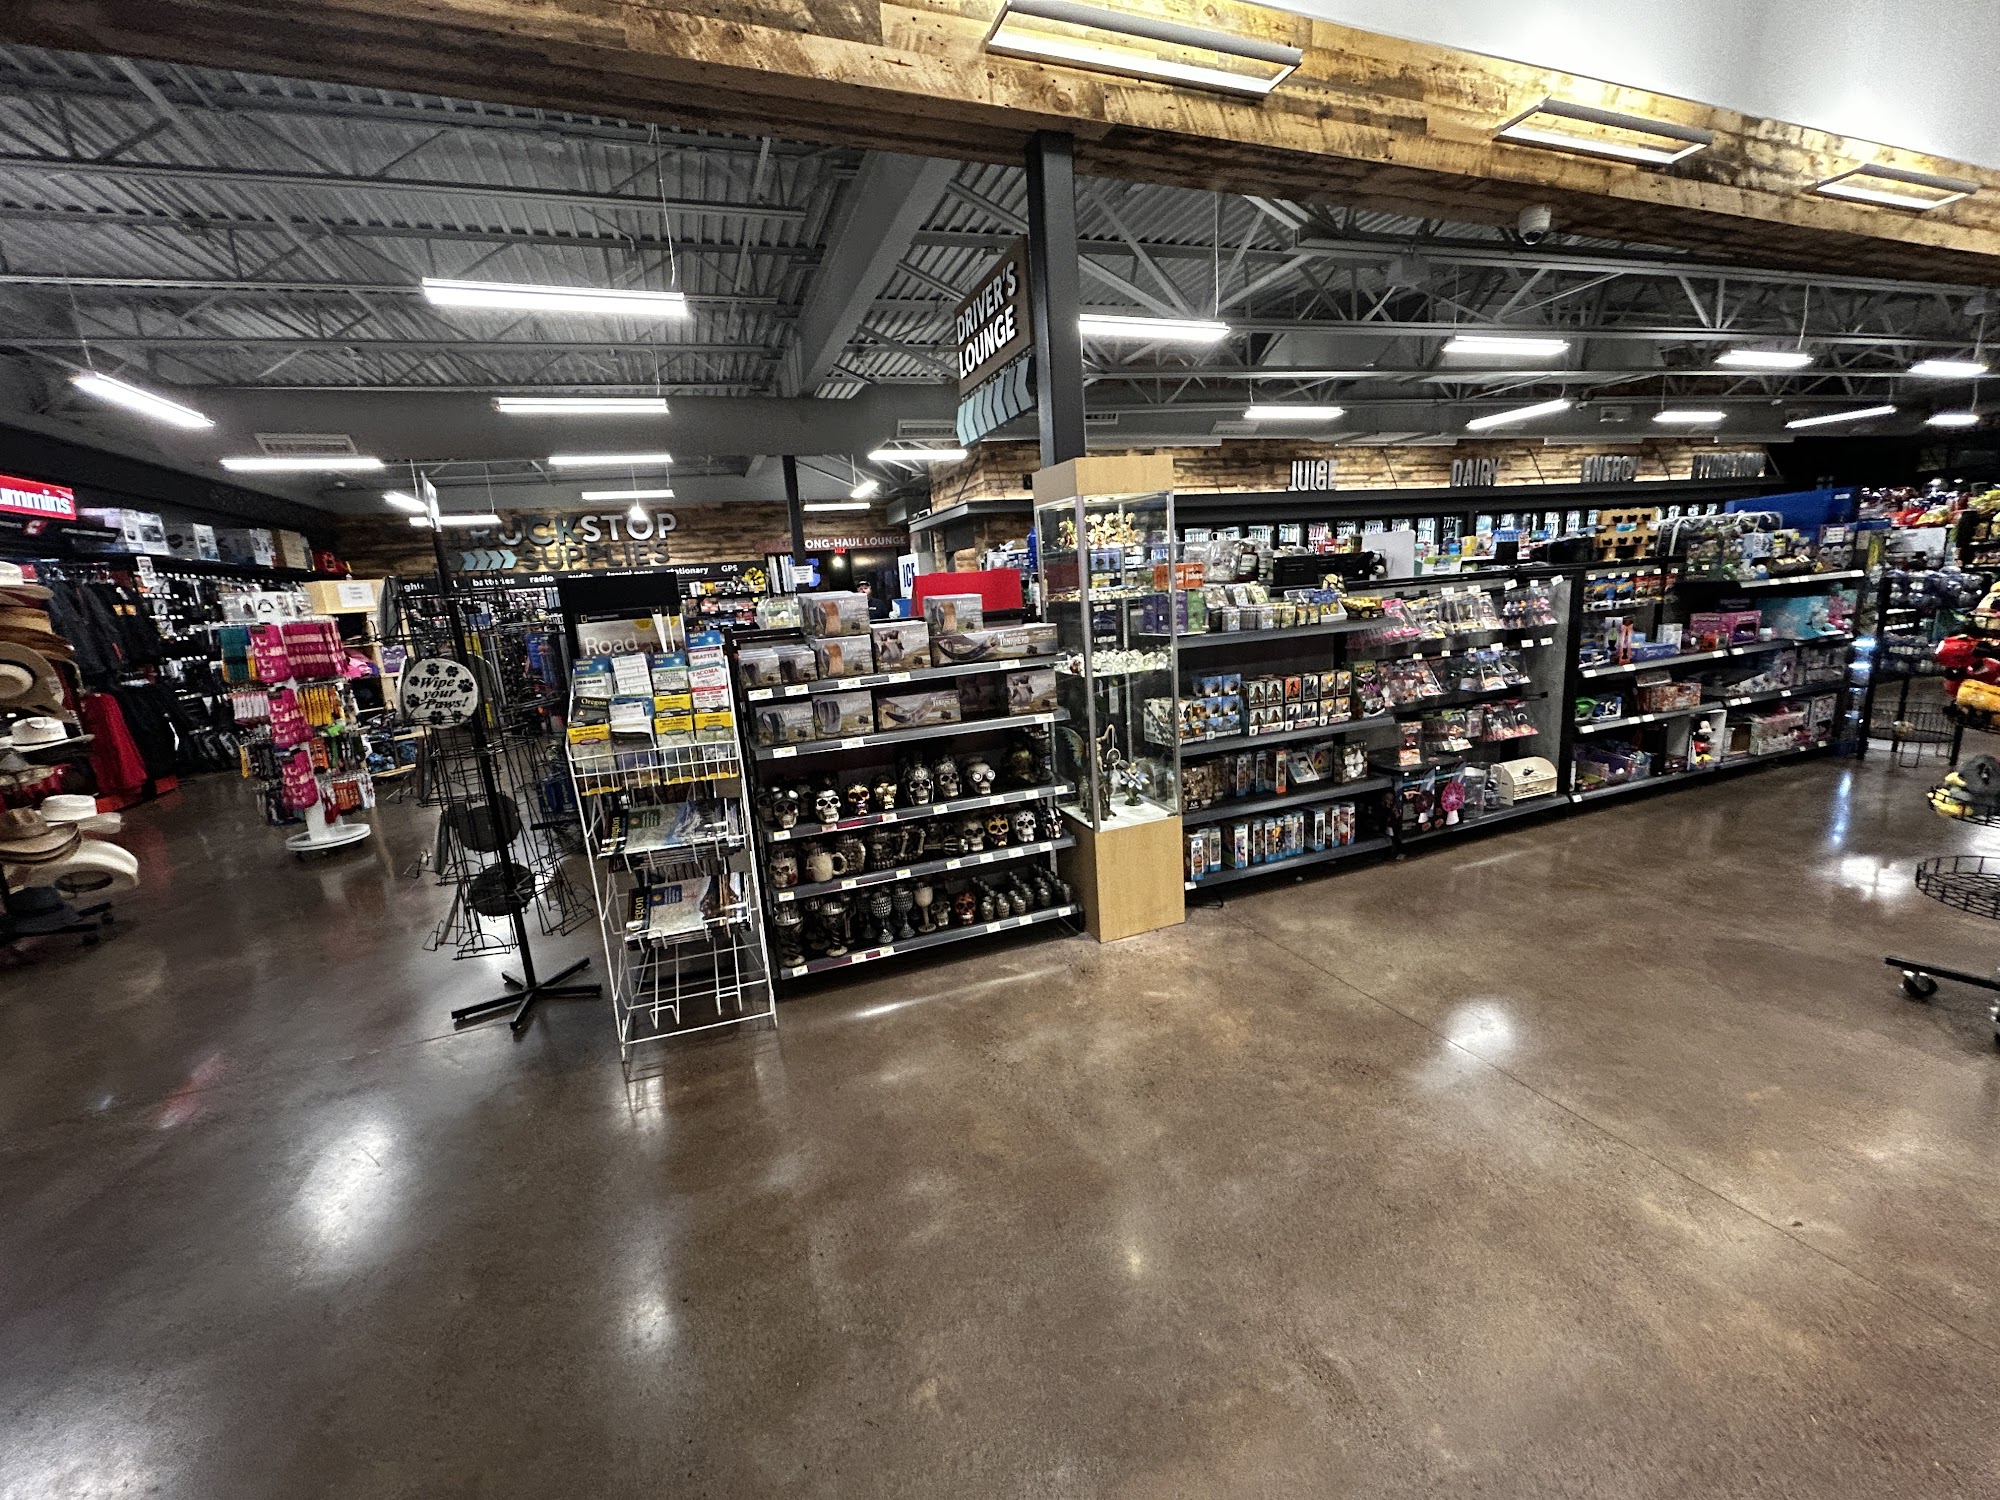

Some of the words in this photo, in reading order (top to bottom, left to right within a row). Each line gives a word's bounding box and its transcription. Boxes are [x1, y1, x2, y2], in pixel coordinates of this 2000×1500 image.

[956, 261, 1017, 346] DRIVER'S
[958, 305, 1016, 380] LOUNGE
[1288, 460, 1338, 491] JUICE
[1451, 459, 1500, 487] DAIRY
[804, 538, 862, 549] ONG-HAUL
[864, 536, 906, 546] LOUNGE
[522, 540, 670, 571] SUPPLIES
[472, 577, 515, 587] batteries
[529, 574, 554, 583] radio
[720, 564, 738, 572] GPS
[584, 632, 638, 656] Road
[692, 652, 718, 660] SEATTLE
[420, 677, 456, 690] Wipe
[690, 667, 719, 677] TACOMA
[421, 689, 457, 702] your
[424, 696, 470, 710] Paws!
[581, 697, 607, 706] Oregon
[630, 896, 645, 931] Oegon
